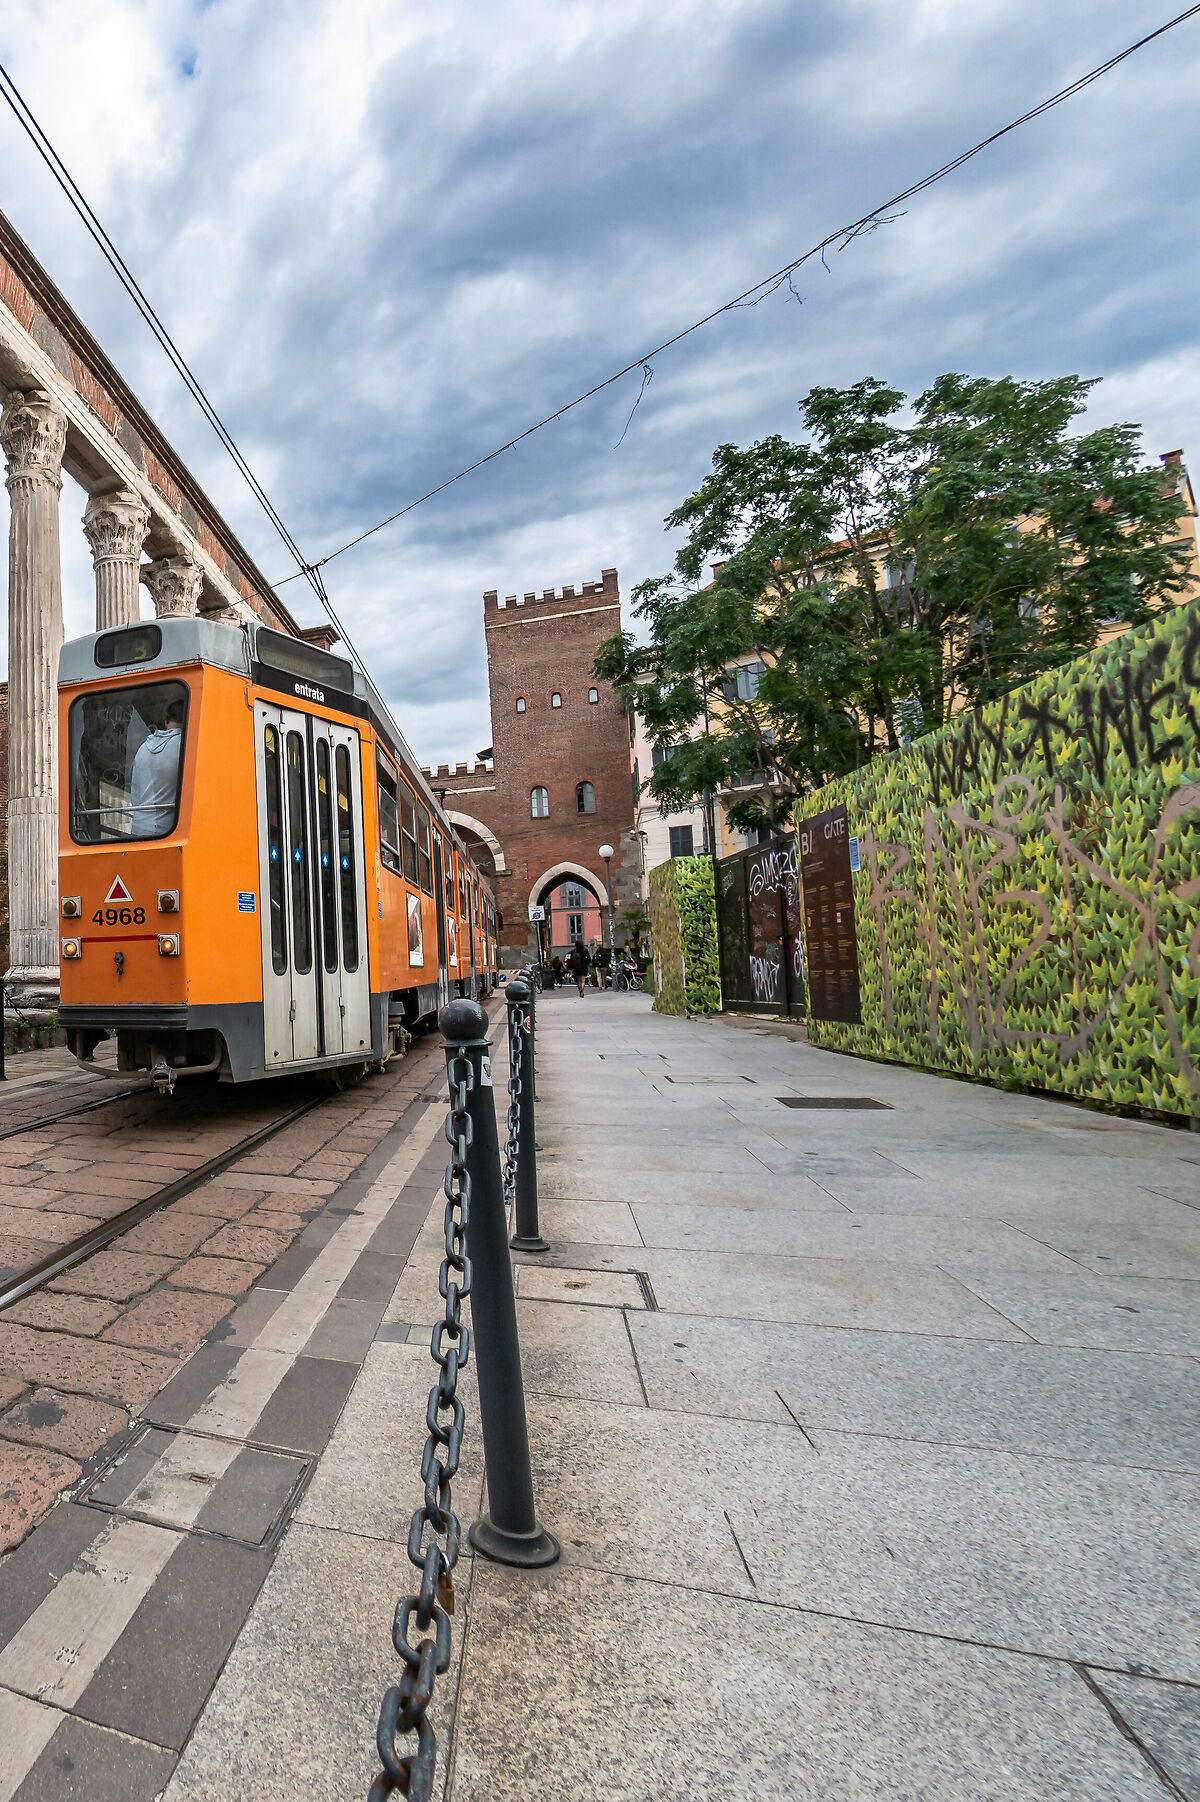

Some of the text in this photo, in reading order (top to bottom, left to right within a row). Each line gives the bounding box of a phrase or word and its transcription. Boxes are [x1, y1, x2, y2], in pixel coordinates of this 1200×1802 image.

[134, 638, 147, 660] 3
[294, 682, 325, 703] entrata
[824, 817, 845, 839] GATE
[92, 907, 146, 926] 4968
